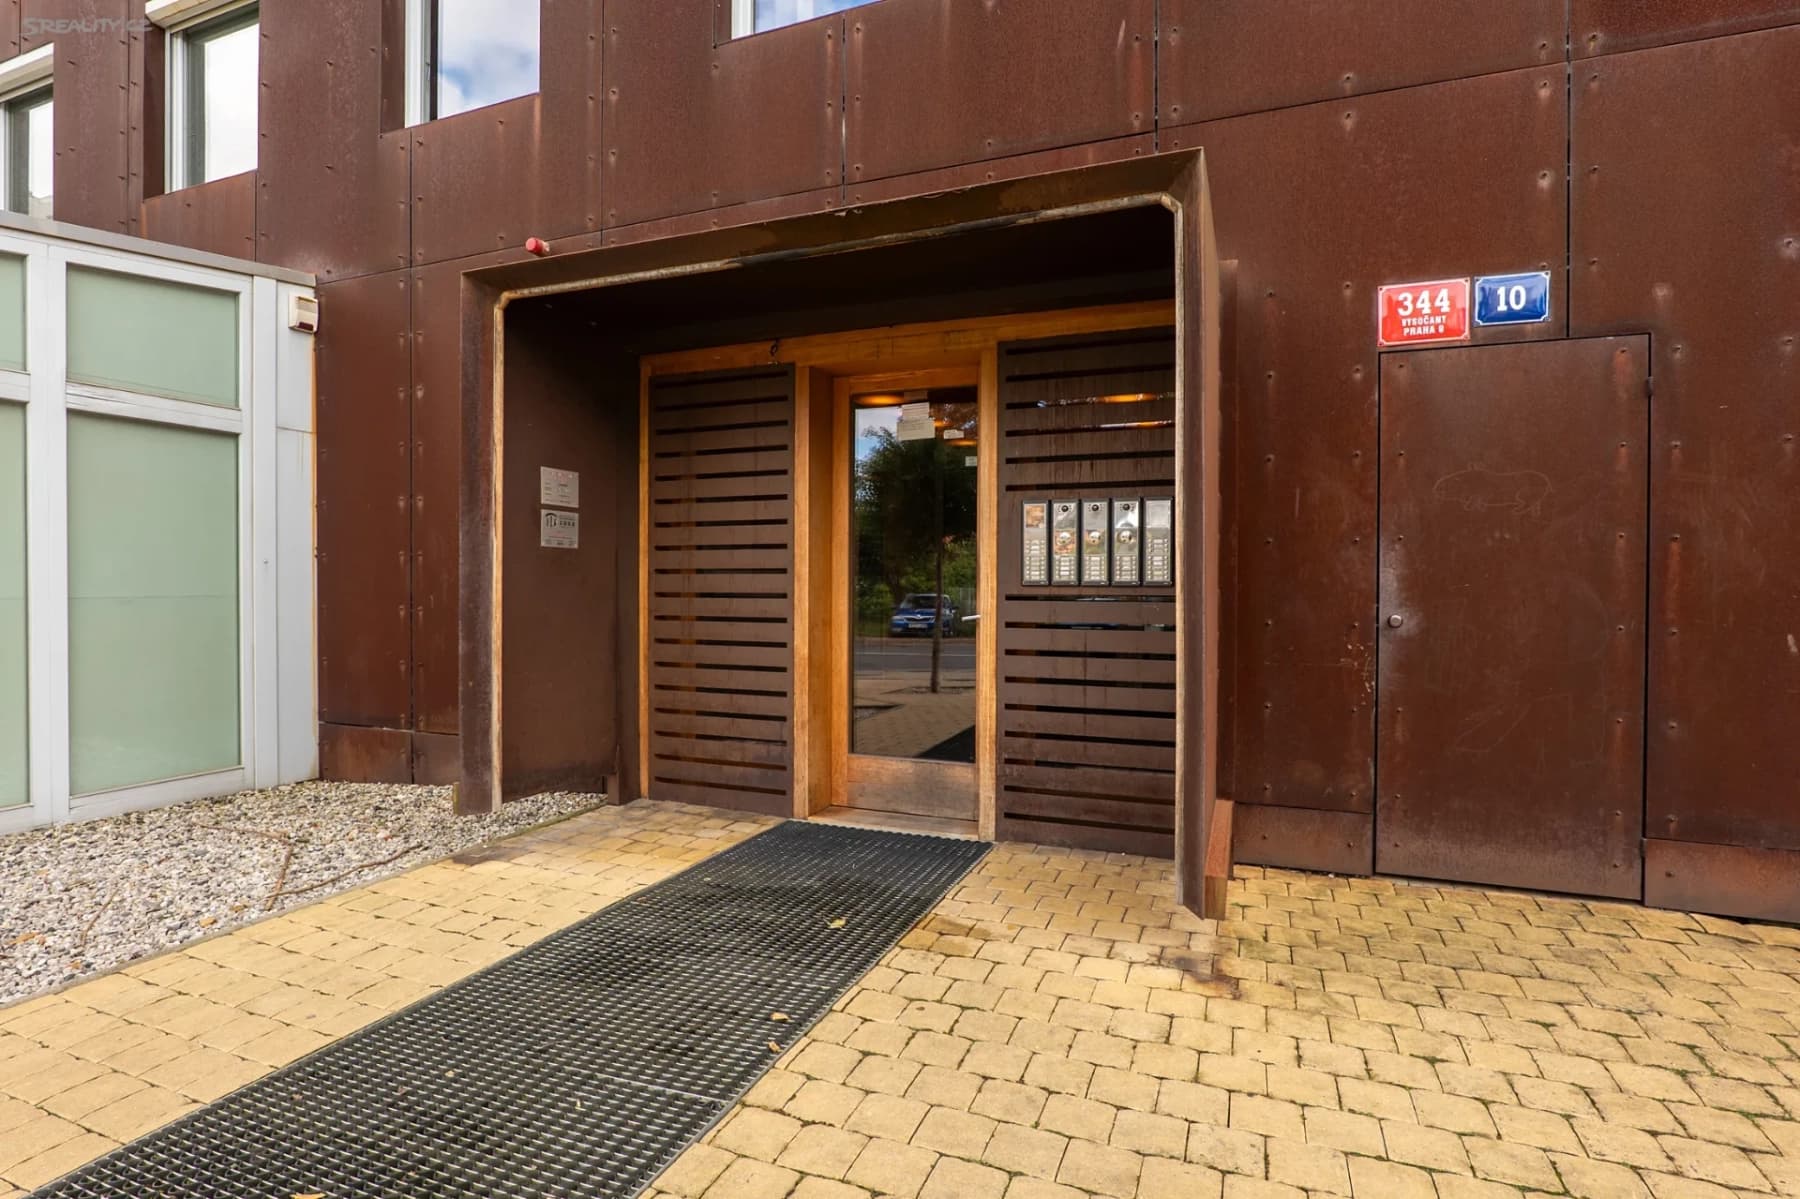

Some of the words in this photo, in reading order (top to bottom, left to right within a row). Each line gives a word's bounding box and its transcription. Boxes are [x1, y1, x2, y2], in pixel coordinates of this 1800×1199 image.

[1397, 288, 1450, 317] 344
[1496, 285, 1527, 312] 10
[1403, 325, 1435, 336] PRAHA
